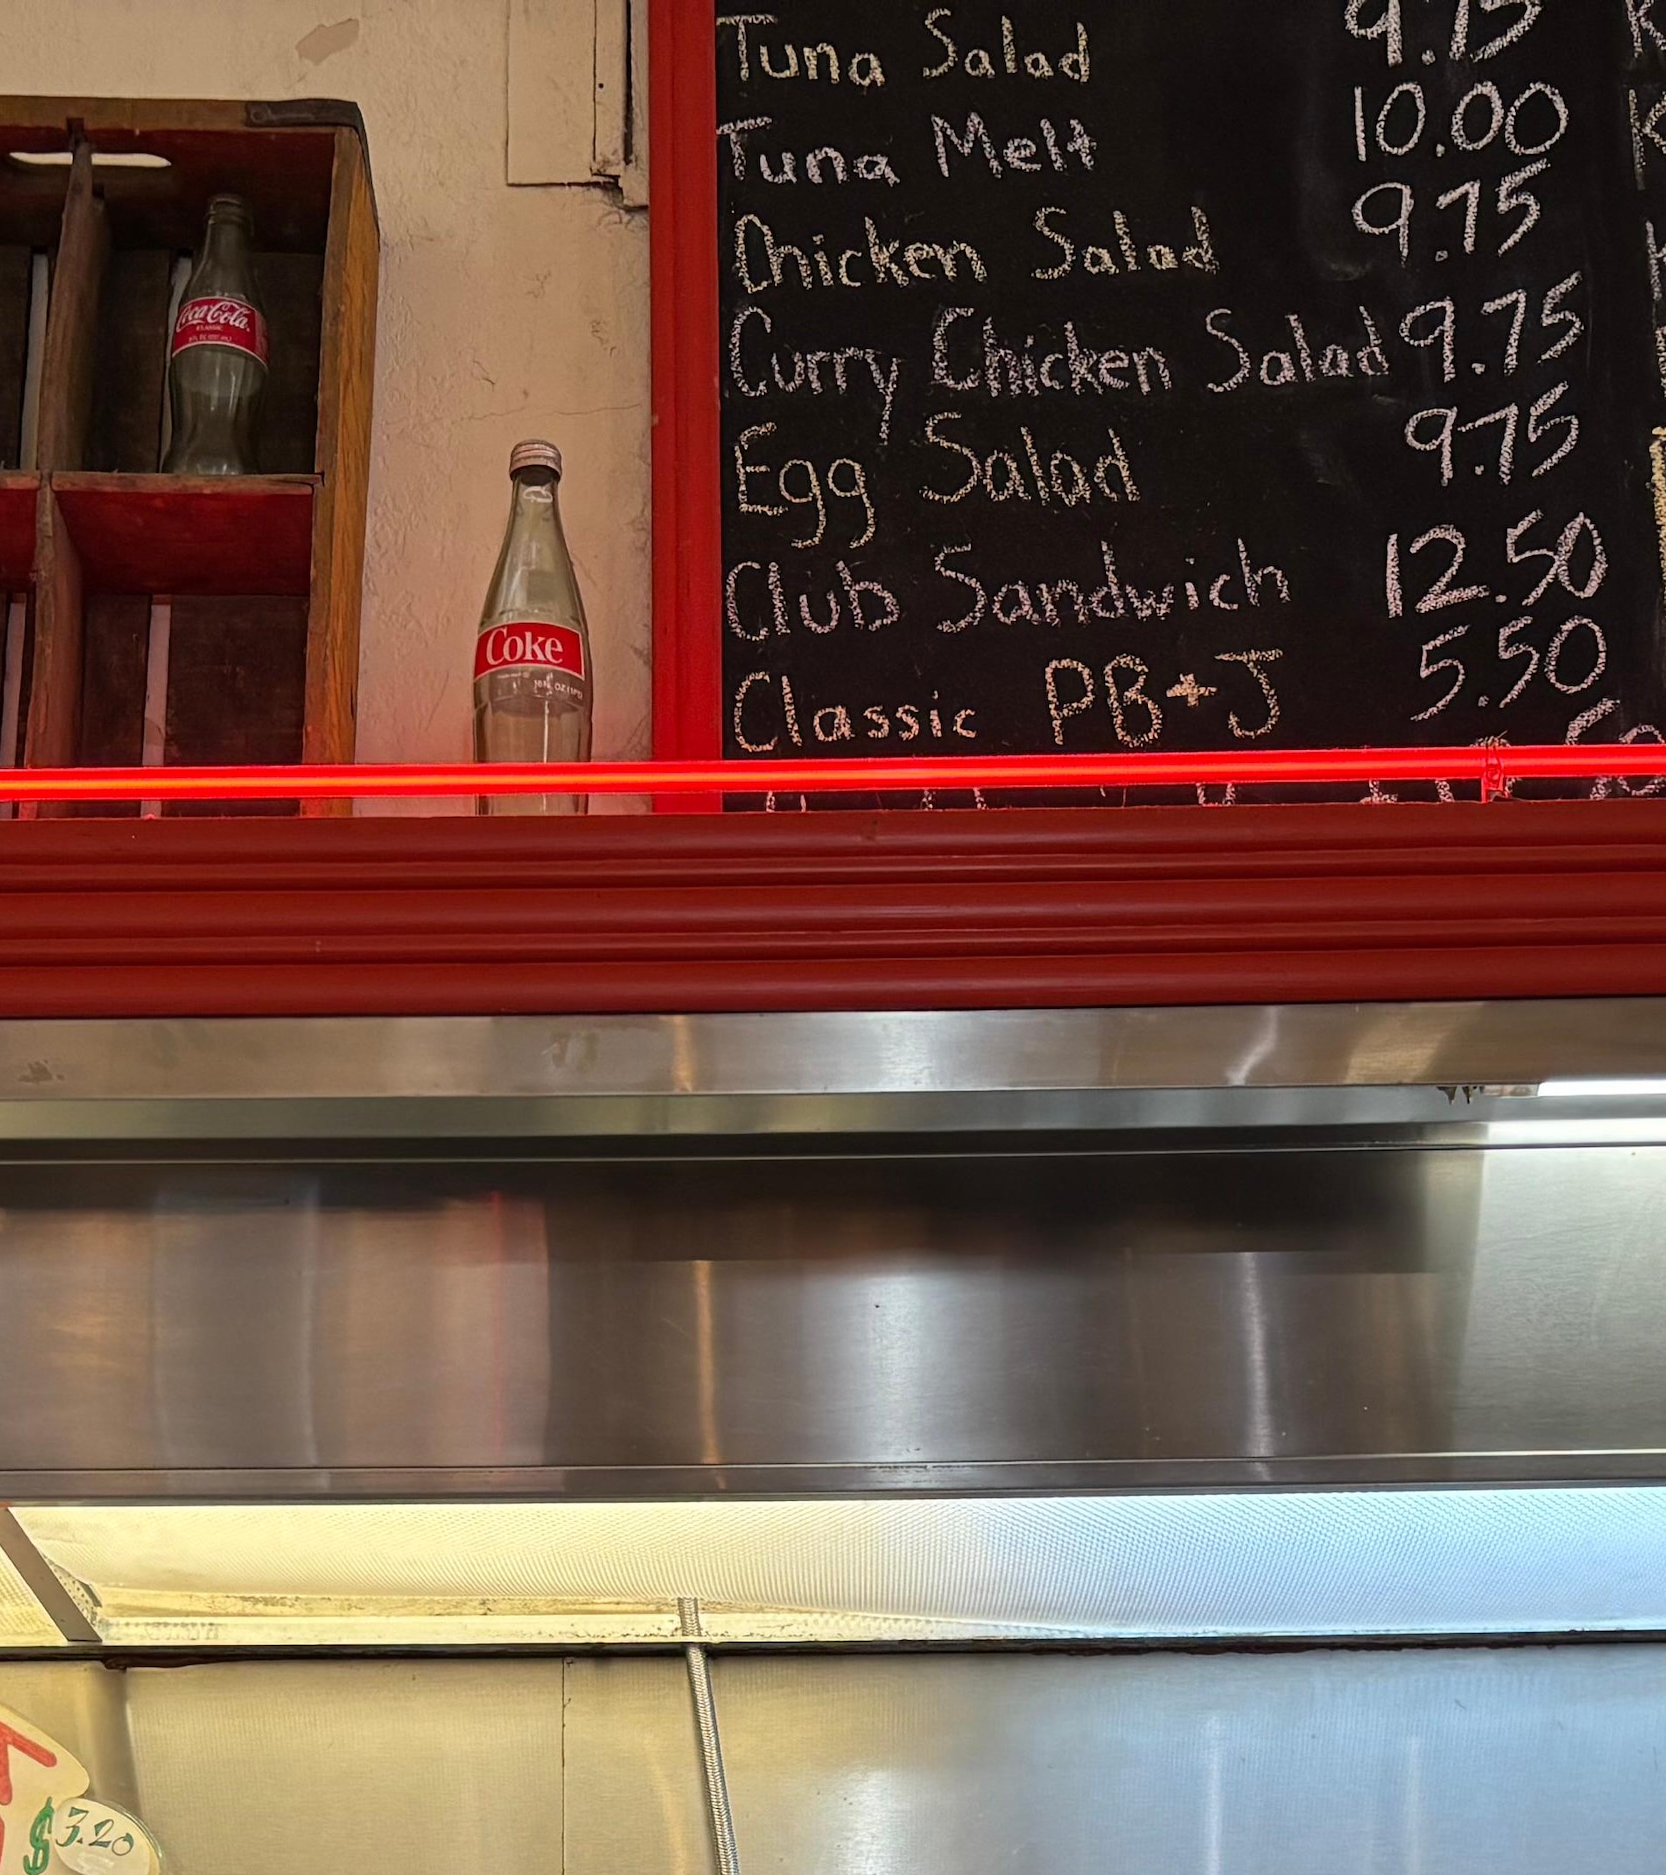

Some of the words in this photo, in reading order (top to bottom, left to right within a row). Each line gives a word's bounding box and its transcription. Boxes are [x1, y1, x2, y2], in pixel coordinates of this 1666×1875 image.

[716, 13, 886, 87] Tuna
[923, 8, 1090, 84] Salad
[716, 115, 901, 187] Tuna
[931, 111, 1099, 178] Melt
[1353, 81, 1569, 162] 10.00
[734, 212, 988, 293] Chicken
[1032, 205, 1220, 280] Salad
[1351, 158, 1551, 268] 9.75
[729, 304, 902, 446] Curry
[931, 304, 1172, 397] Chicken
[1206, 304, 1391, 394] Salad
[1399, 271, 1585, 382] 9.75
[735, 421, 876, 549] Egg
[919, 411, 1141, 506] Salad
[1404, 381, 1580, 487] 9.75
[725, 558, 902, 641] Club
[933, 536, 1291, 634] Sandwich
[1387, 508, 1609, 620] 12.50
[486, 626, 564, 666] Coke
[734, 670, 978, 753] Classic
[1410, 615, 1607, 722] 5.50
